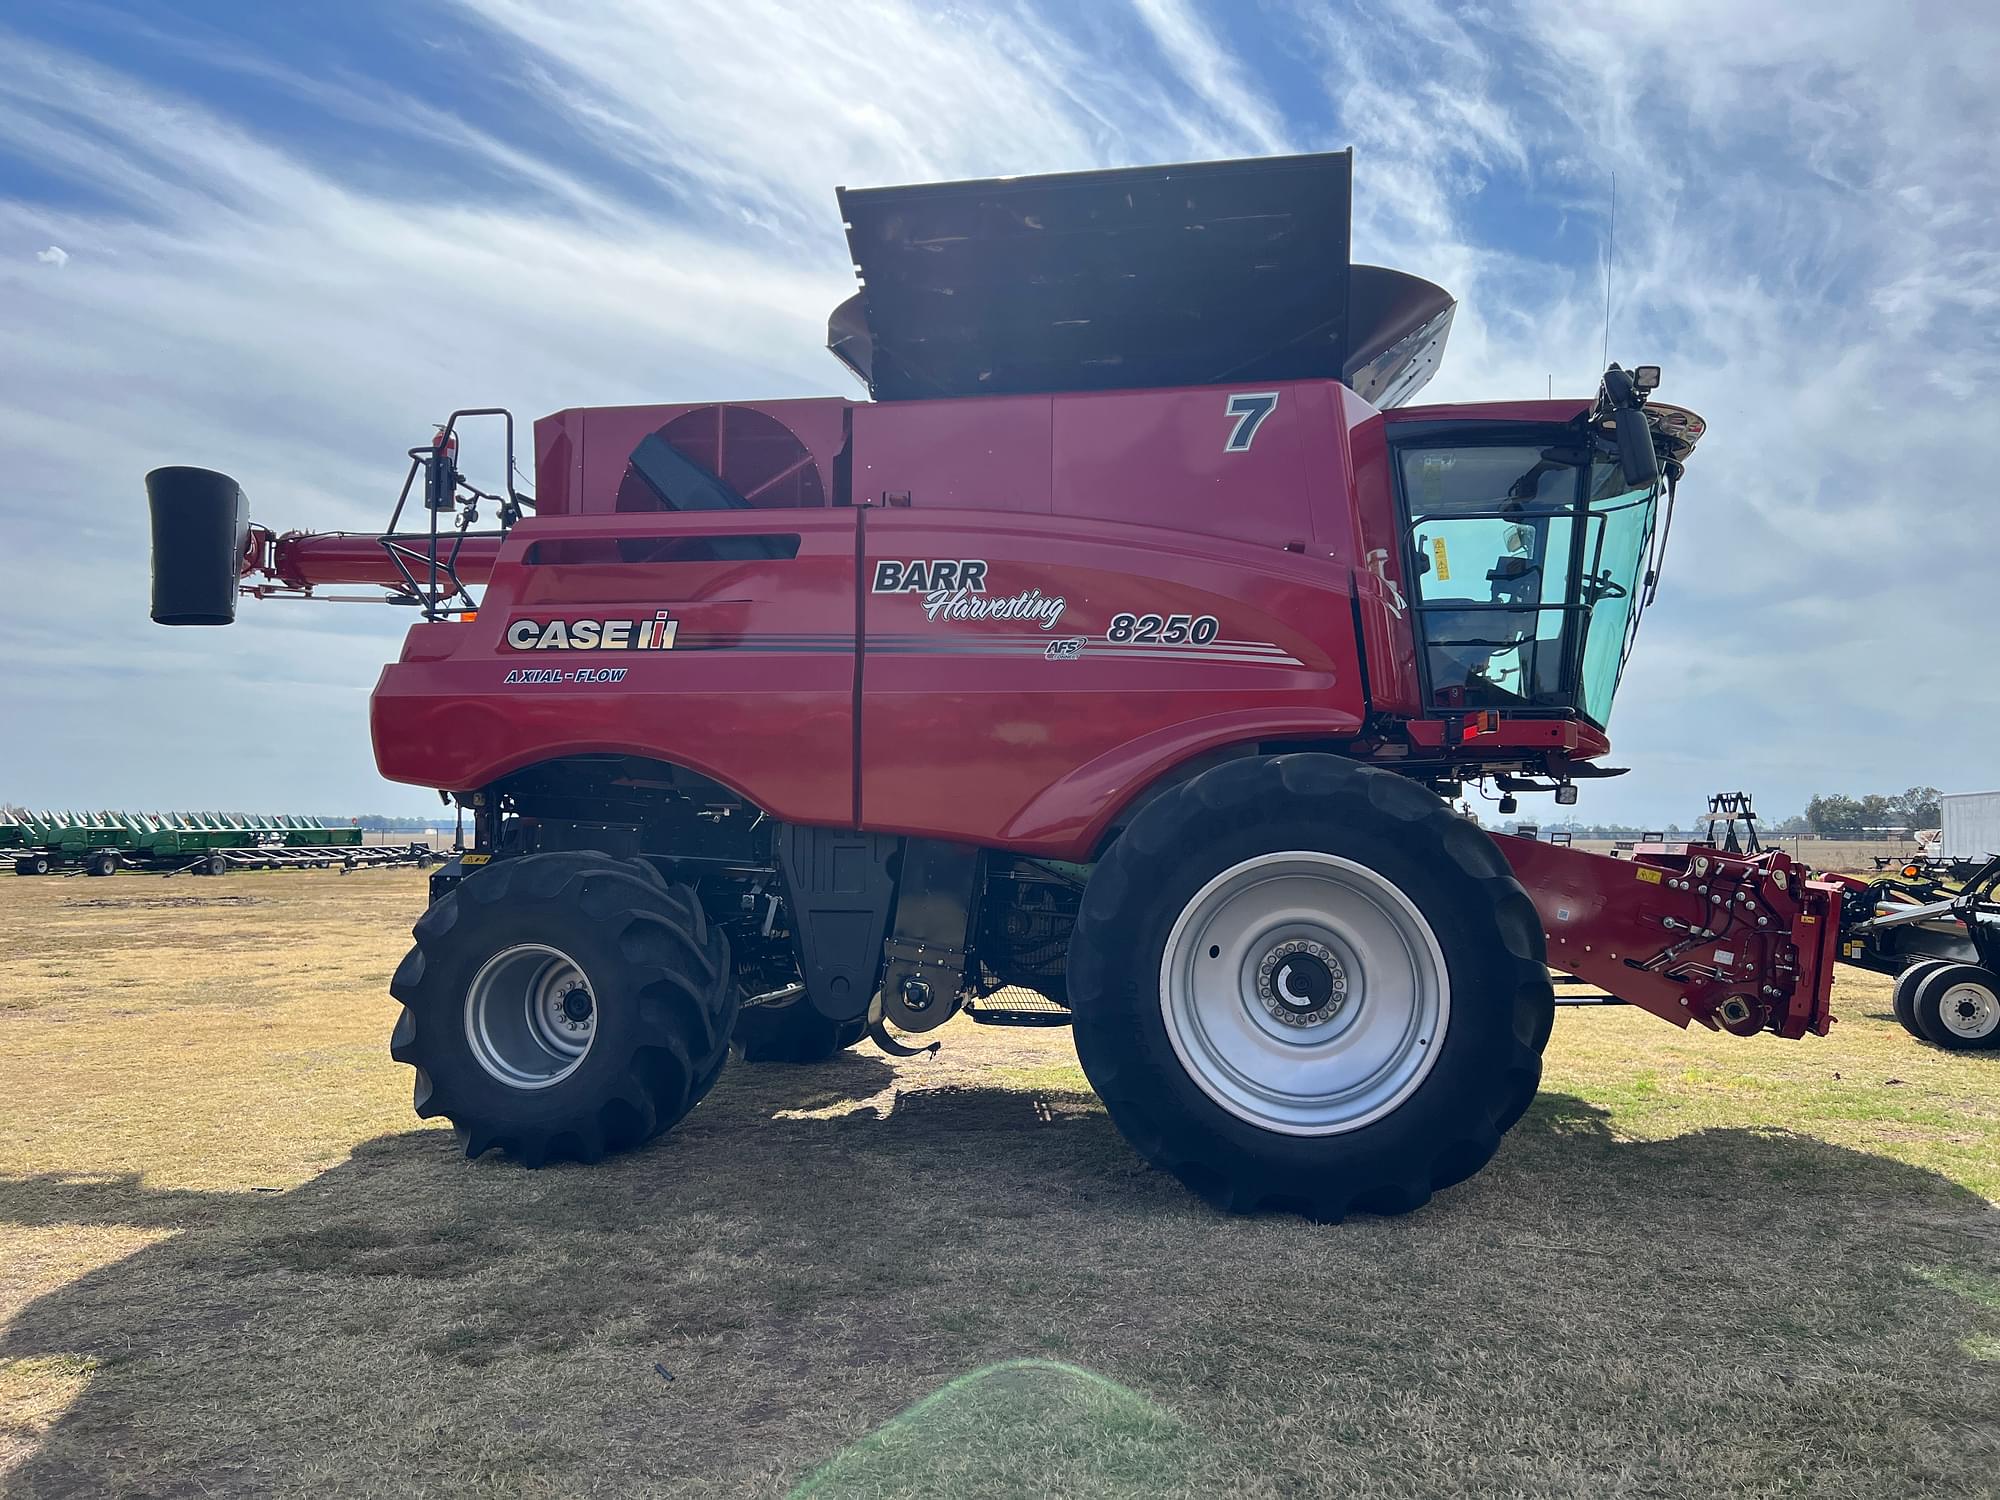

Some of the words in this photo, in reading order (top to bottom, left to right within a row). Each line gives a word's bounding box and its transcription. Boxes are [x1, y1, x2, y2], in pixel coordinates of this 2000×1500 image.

[1224, 391, 1279, 452] 7
[872, 560, 988, 593] BARR
[921, 587, 1066, 630] Harvesting
[507, 619, 633, 650] CASE
[1106, 613, 1220, 646] 8250
[1044, 639, 1080, 654] AFS
[504, 668, 628, 684] AXIAL-FLOW
